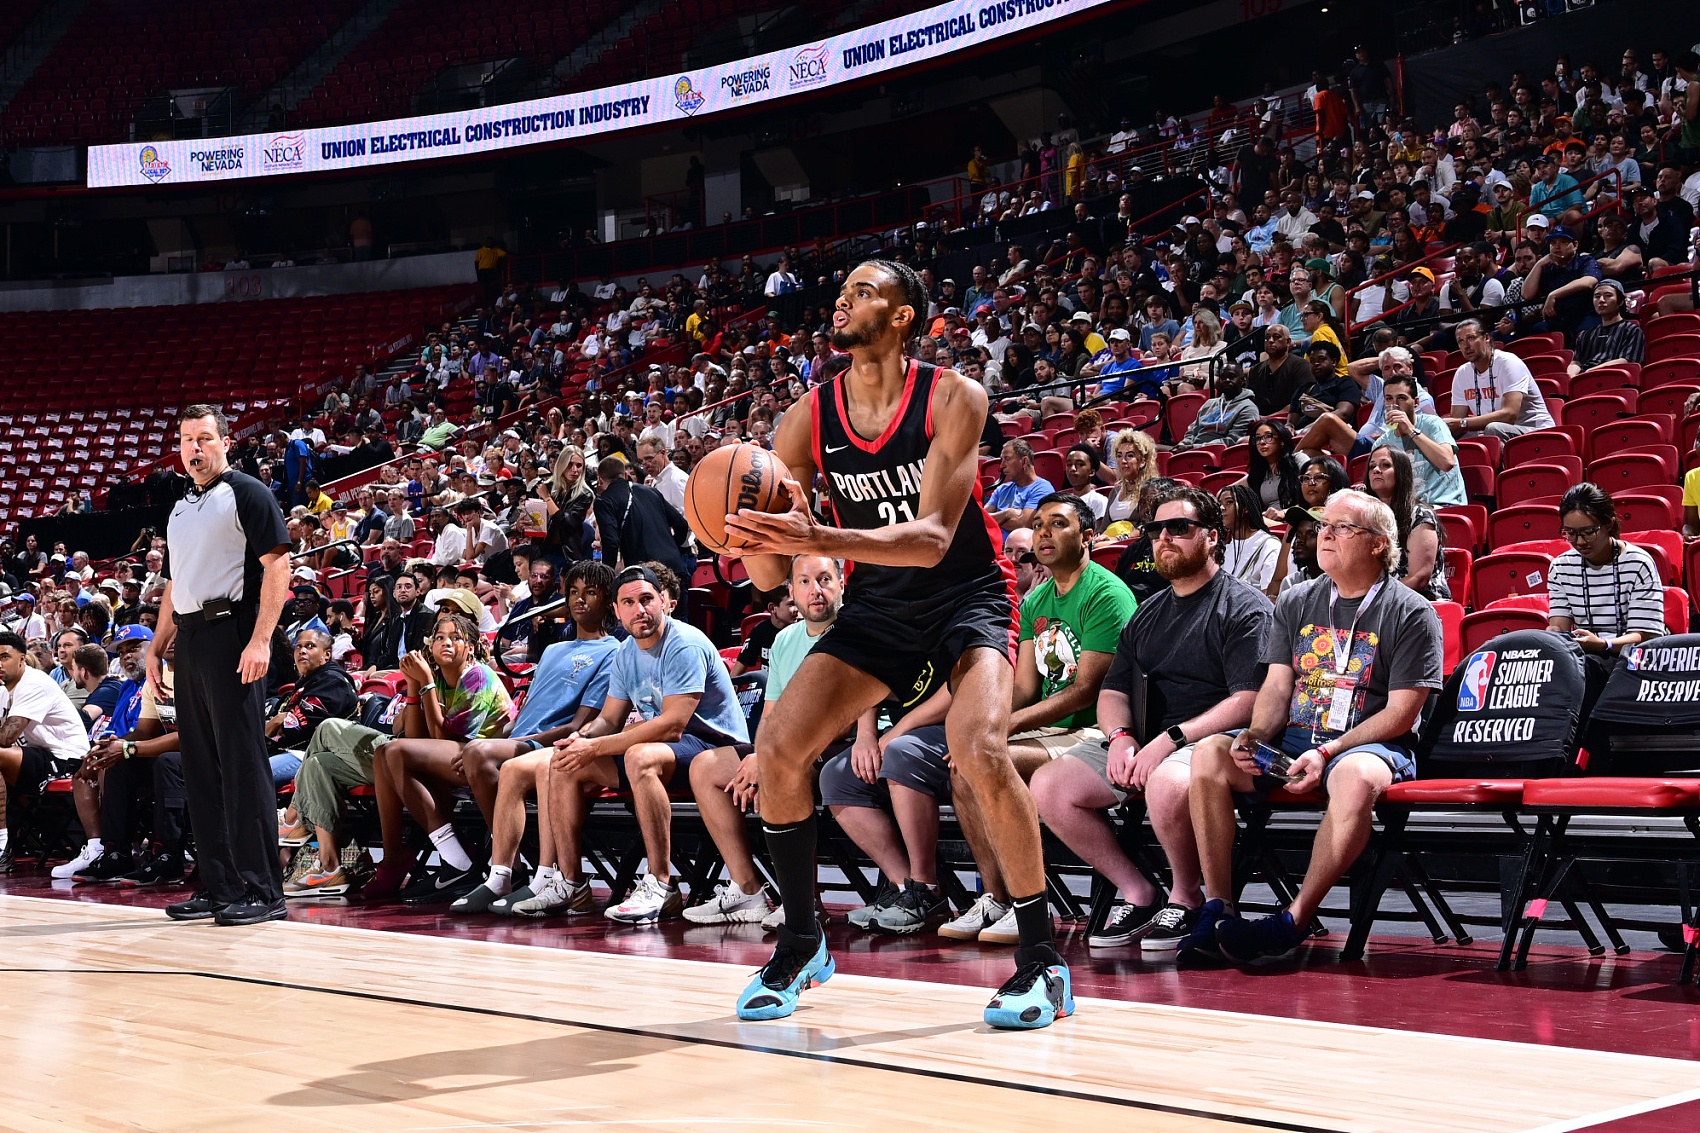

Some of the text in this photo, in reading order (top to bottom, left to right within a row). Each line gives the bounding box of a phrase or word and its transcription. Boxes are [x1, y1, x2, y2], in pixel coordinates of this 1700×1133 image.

[842, 0, 1070, 69] UNION ELECTRICAL CONSTRU
[721, 66, 771, 89] POWERING
[789, 58, 827, 82] NECA
[731, 79, 770, 98] NEVADA
[321, 95, 650, 160] UNION ELECTRICAL CONSTRUCTION INDUSTRY
[190, 148, 244, 162] POWERING
[201, 159, 242, 172] NEVADA
[263, 147, 302, 163] NECA
[226, 274, 262, 298] 103
[735, 450, 763, 515] Wilson
[830, 458, 927, 502] PORTLAN
[878, 500, 915, 526] 21
[1501, 649, 1541, 660] NBA2K
[1640, 647, 1700, 671] EXPERIE
[1495, 660, 1554, 685] SUMMER
[1460, 697, 1474, 708] NBA
[1489, 684, 1541, 709] LEAGUE
[1453, 718, 1535, 743] RESERVED
